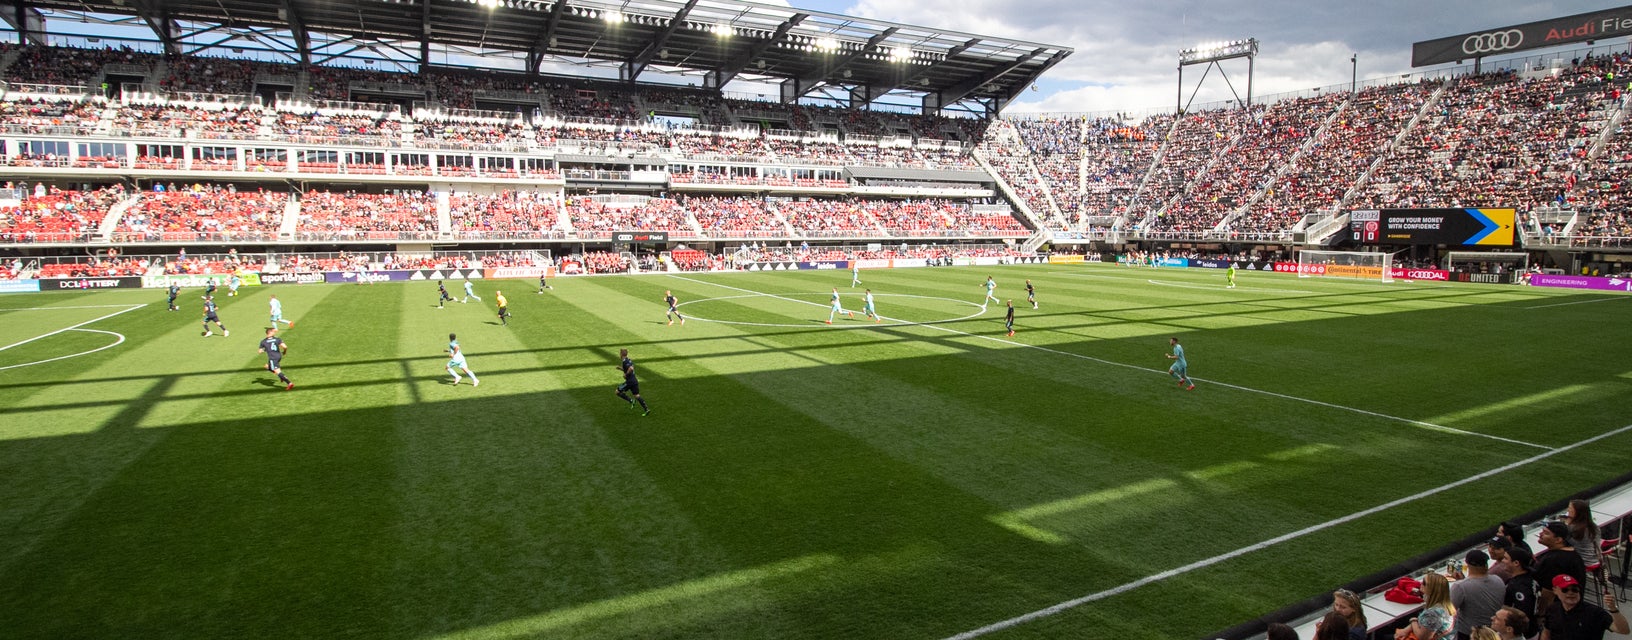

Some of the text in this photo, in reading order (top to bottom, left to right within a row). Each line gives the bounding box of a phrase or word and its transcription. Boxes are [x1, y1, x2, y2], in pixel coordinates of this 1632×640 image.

[1545, 22, 1595, 41] Audi
[1353, 231, 1360, 240] 0
[1367, 231, 1374, 240] 0
[262, 273, 325, 283] sport&health
[1471, 273, 1499, 283] UNITED
[1541, 278, 1588, 286] ENGINEERING
[271, 342, 277, 351] 4
